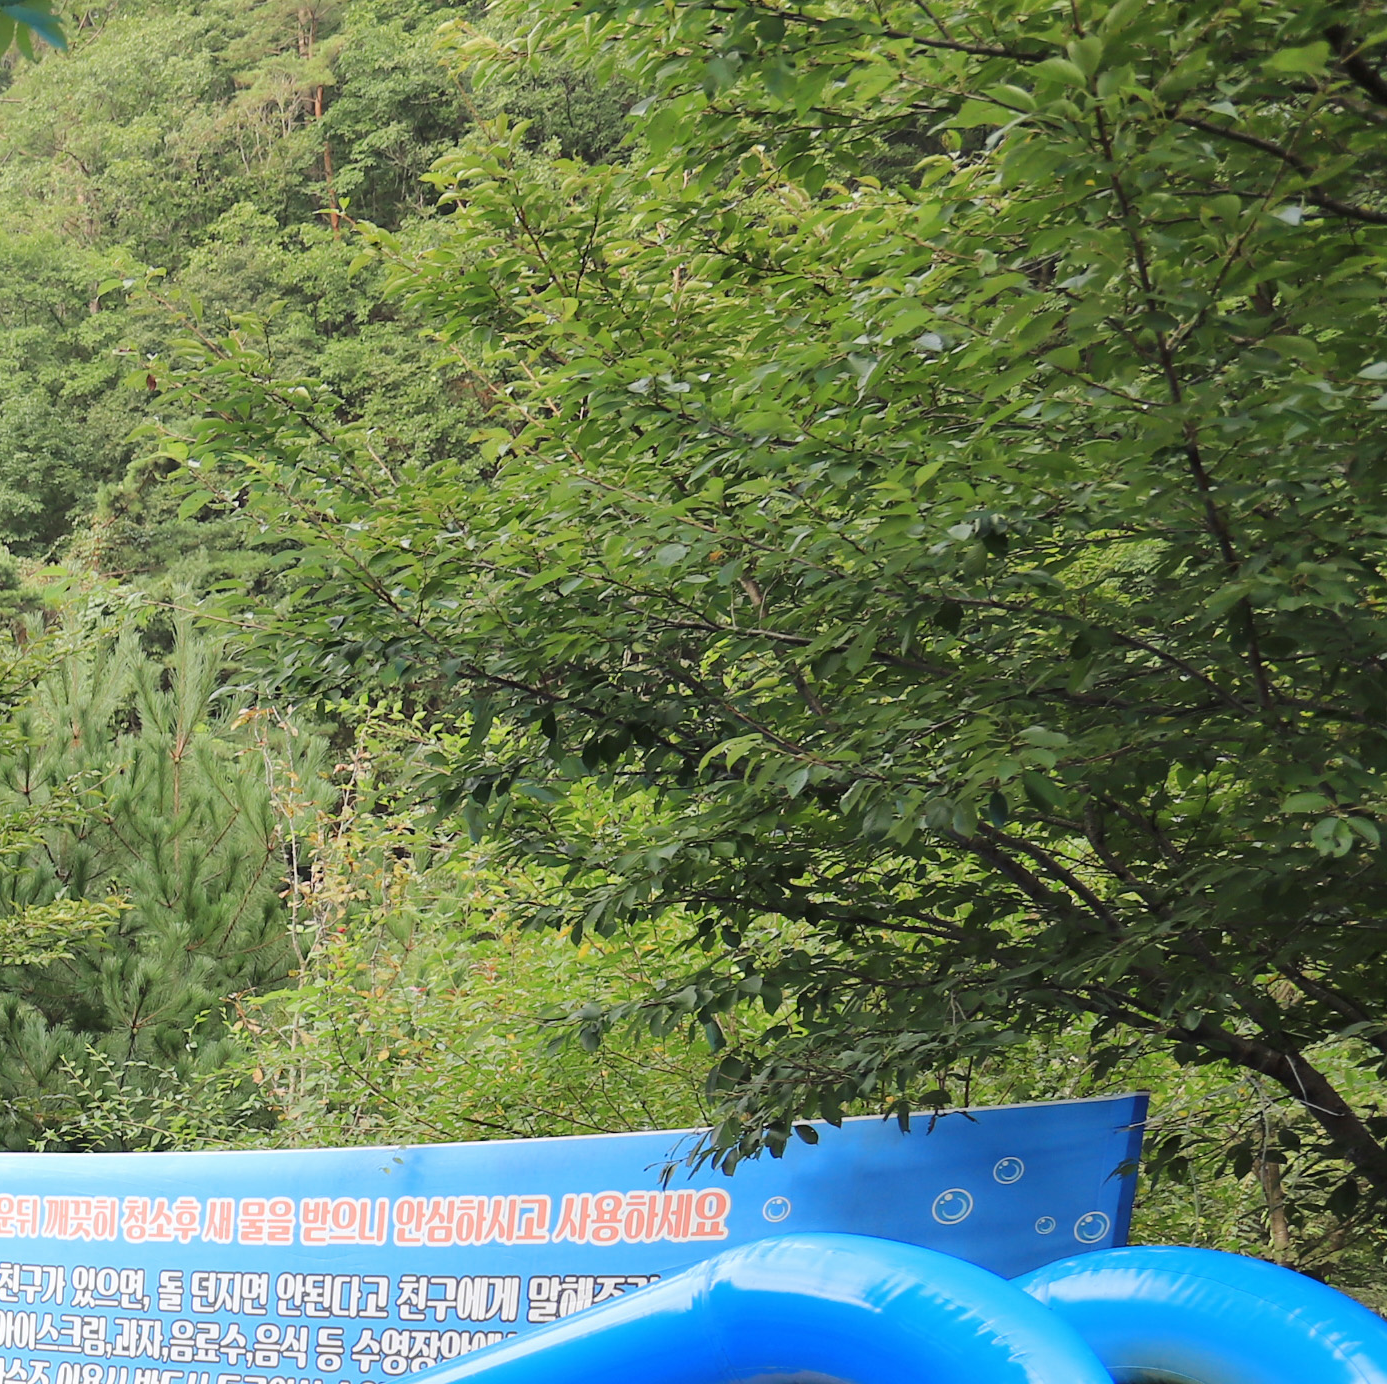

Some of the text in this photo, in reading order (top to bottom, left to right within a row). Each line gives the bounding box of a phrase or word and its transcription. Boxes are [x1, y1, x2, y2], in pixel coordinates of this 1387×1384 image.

[44, 1199, 116, 1239] 깨끗히
[124, 1199, 198, 1241] 청소후
[205, 1200, 232, 1242] 새
[240, 1199, 292, 1242] 물을
[303, 1199, 385, 1242] 받으니
[395, 1198, 547, 1243] 안심하시고
[555, 1192, 727, 1242] 사용하세요
[71, 1265, 151, 1312] 있으면,
[157, 1270, 184, 1313] 돌
[190, 1270, 270, 1316] 던지면
[276, 1271, 390, 1319] 안된다고
[396, 1273, 520, 1322] 친구에게
[315, 1326, 345, 1372] 등
